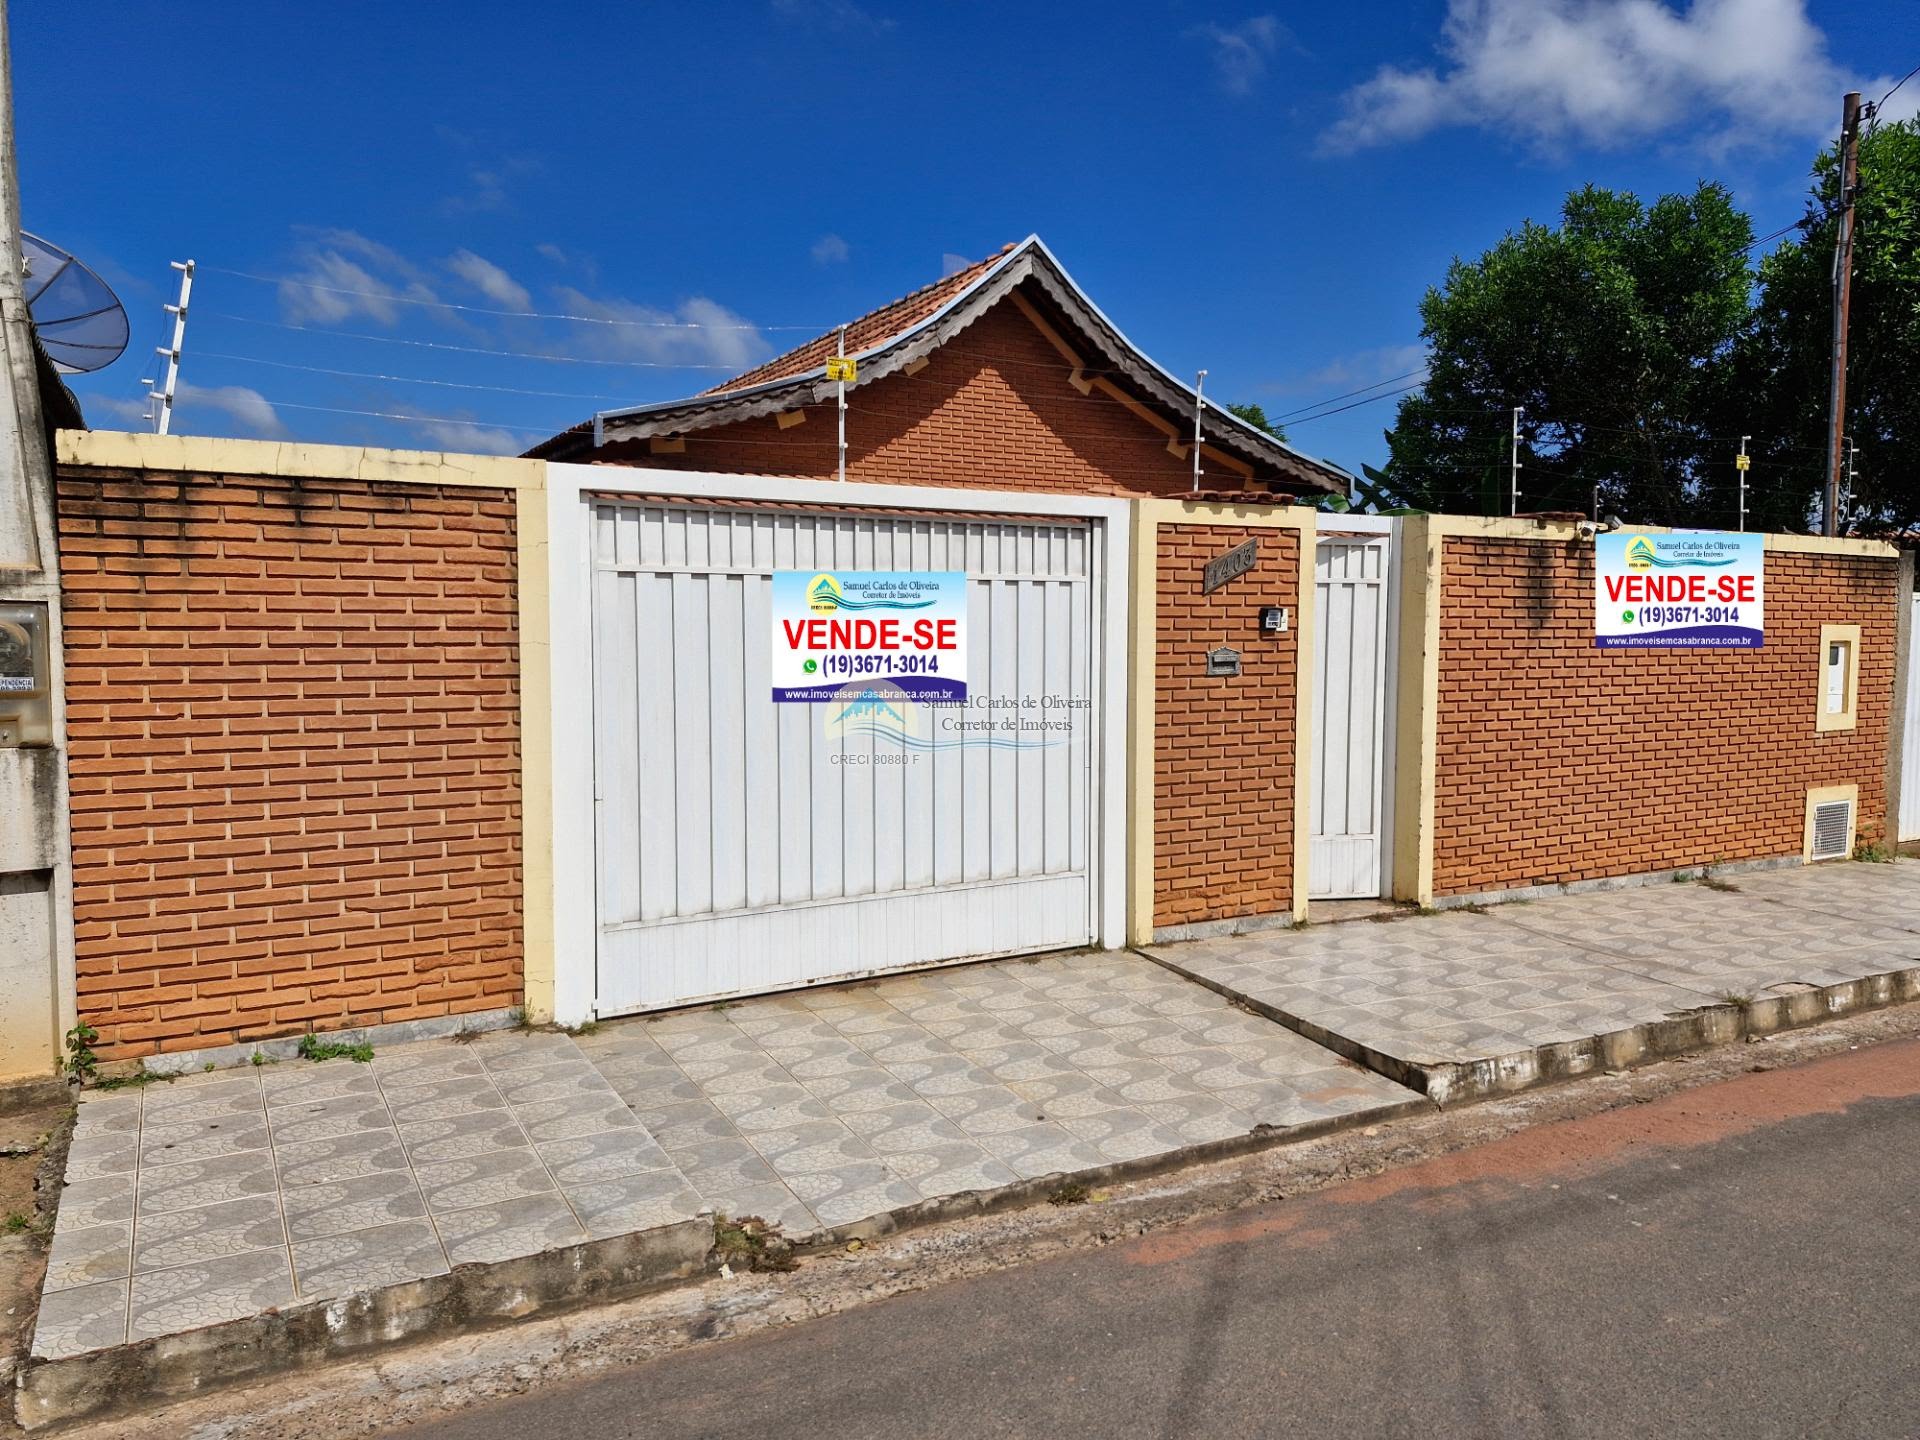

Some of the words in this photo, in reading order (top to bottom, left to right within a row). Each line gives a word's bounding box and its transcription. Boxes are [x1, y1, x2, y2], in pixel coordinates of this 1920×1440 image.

[1656, 541, 1681, 550] Samuel
[1682, 541, 1703, 550] Carlos
[1704, 541, 1713, 550] de
[1714, 541, 1741, 550] Oliveira
[843, 581, 871, 591] Samuel
[872, 581, 897, 591] Carlos
[898, 581, 907, 591] de
[909, 581, 940, 591] Oliveira
[1604, 575, 1755, 603] VENDE-SE
[888, 591, 896, 599] de
[1639, 606, 1740, 627] (19)3671-3014
[782, 619, 957, 650] VENDE-SE
[1606, 636, 1752, 646] www.imoveisemcasabranca.com.br
[822, 654, 939, 678] (19)3671-3014
[784, 688, 953, 699] www.imoveisemcasabranca.com.br
